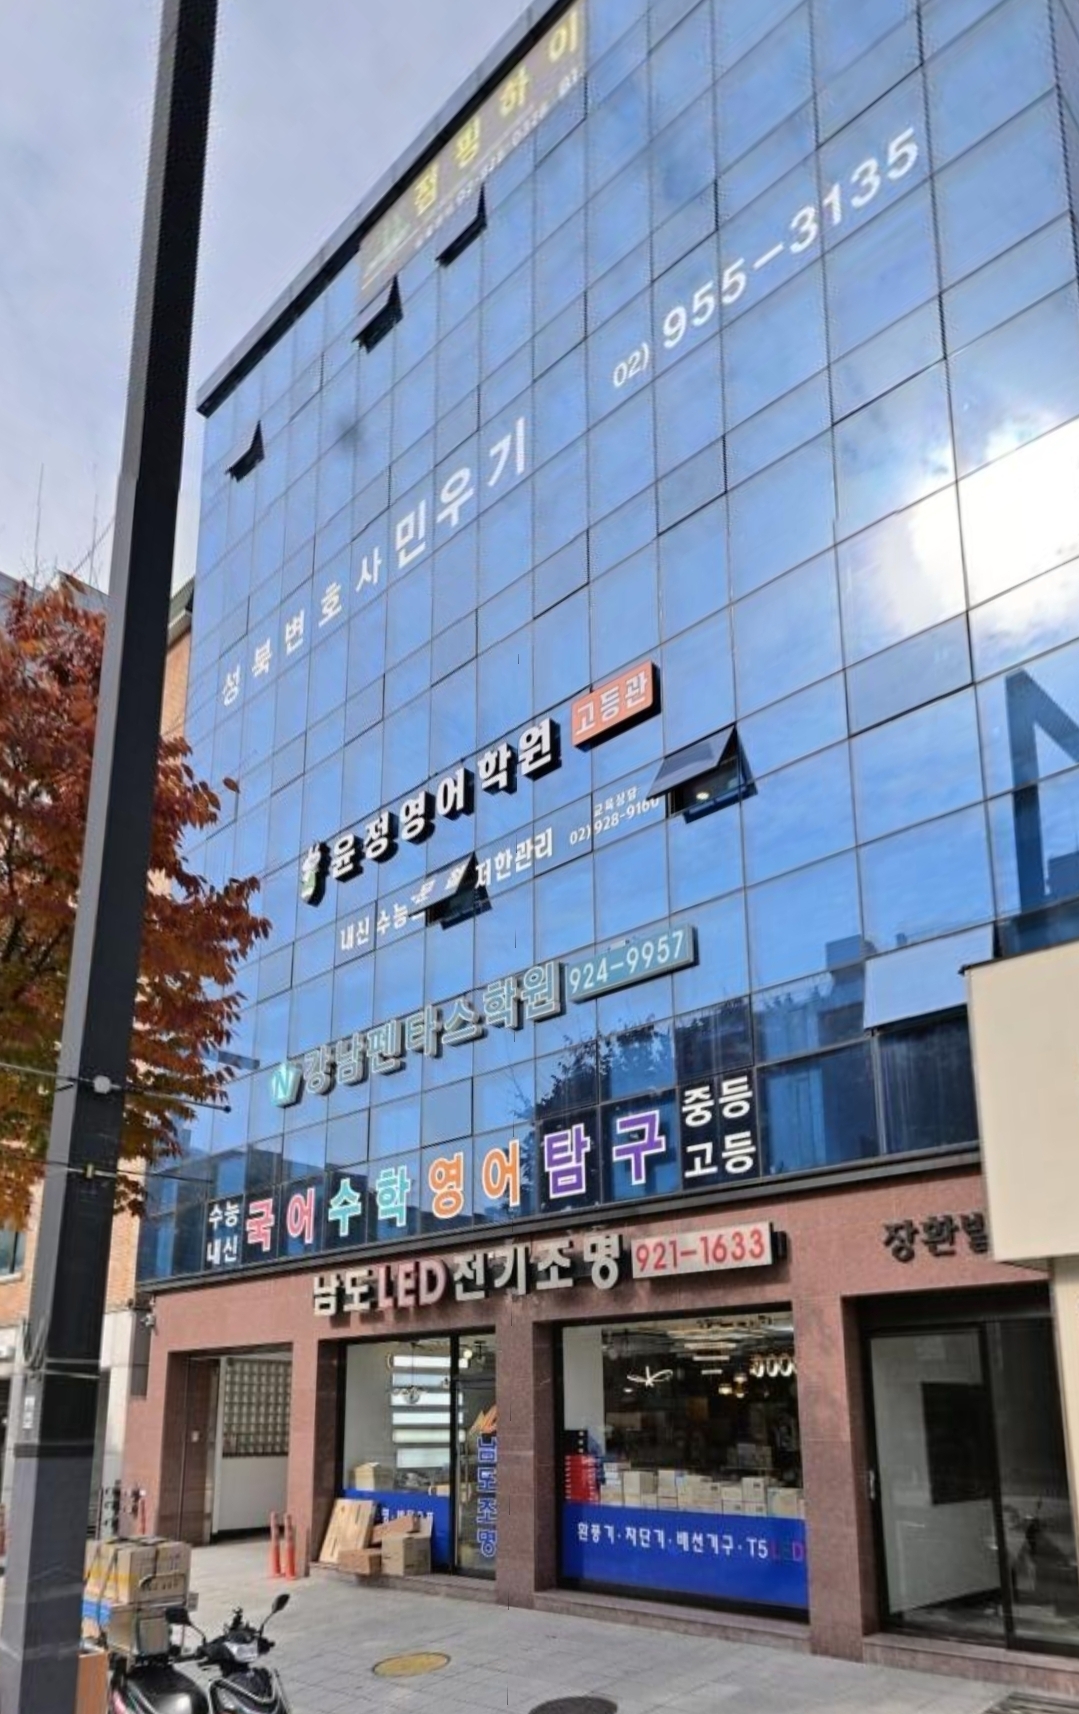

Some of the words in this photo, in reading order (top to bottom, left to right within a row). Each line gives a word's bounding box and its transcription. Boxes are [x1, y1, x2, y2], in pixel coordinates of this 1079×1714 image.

[612, 341, 650, 388] 02)
[662, 127, 919, 350] 955-3135
[222, 545, 384, 707] 성북변호사
[393, 415, 527, 570] 민우기
[574, 670, 650, 737] 고등관
[339, 915, 370, 951] 내신
[568, 930, 687, 995] 924-9957
[303, 960, 560, 1095] 강남펜타스학원
[682, 1075, 754, 1128] 중등
[245, 1186, 316, 1253] 국어
[327, 1164, 412, 1238] 수학
[427, 1138, 522, 1220] 영어
[543, 1108, 668, 1200] 탐구
[684, 1130, 757, 1180] 고등
[208, 1200, 240, 1231] 수능
[206, 1235, 239, 1266] 내신
[633, 1229, 767, 1274] 921-1633
